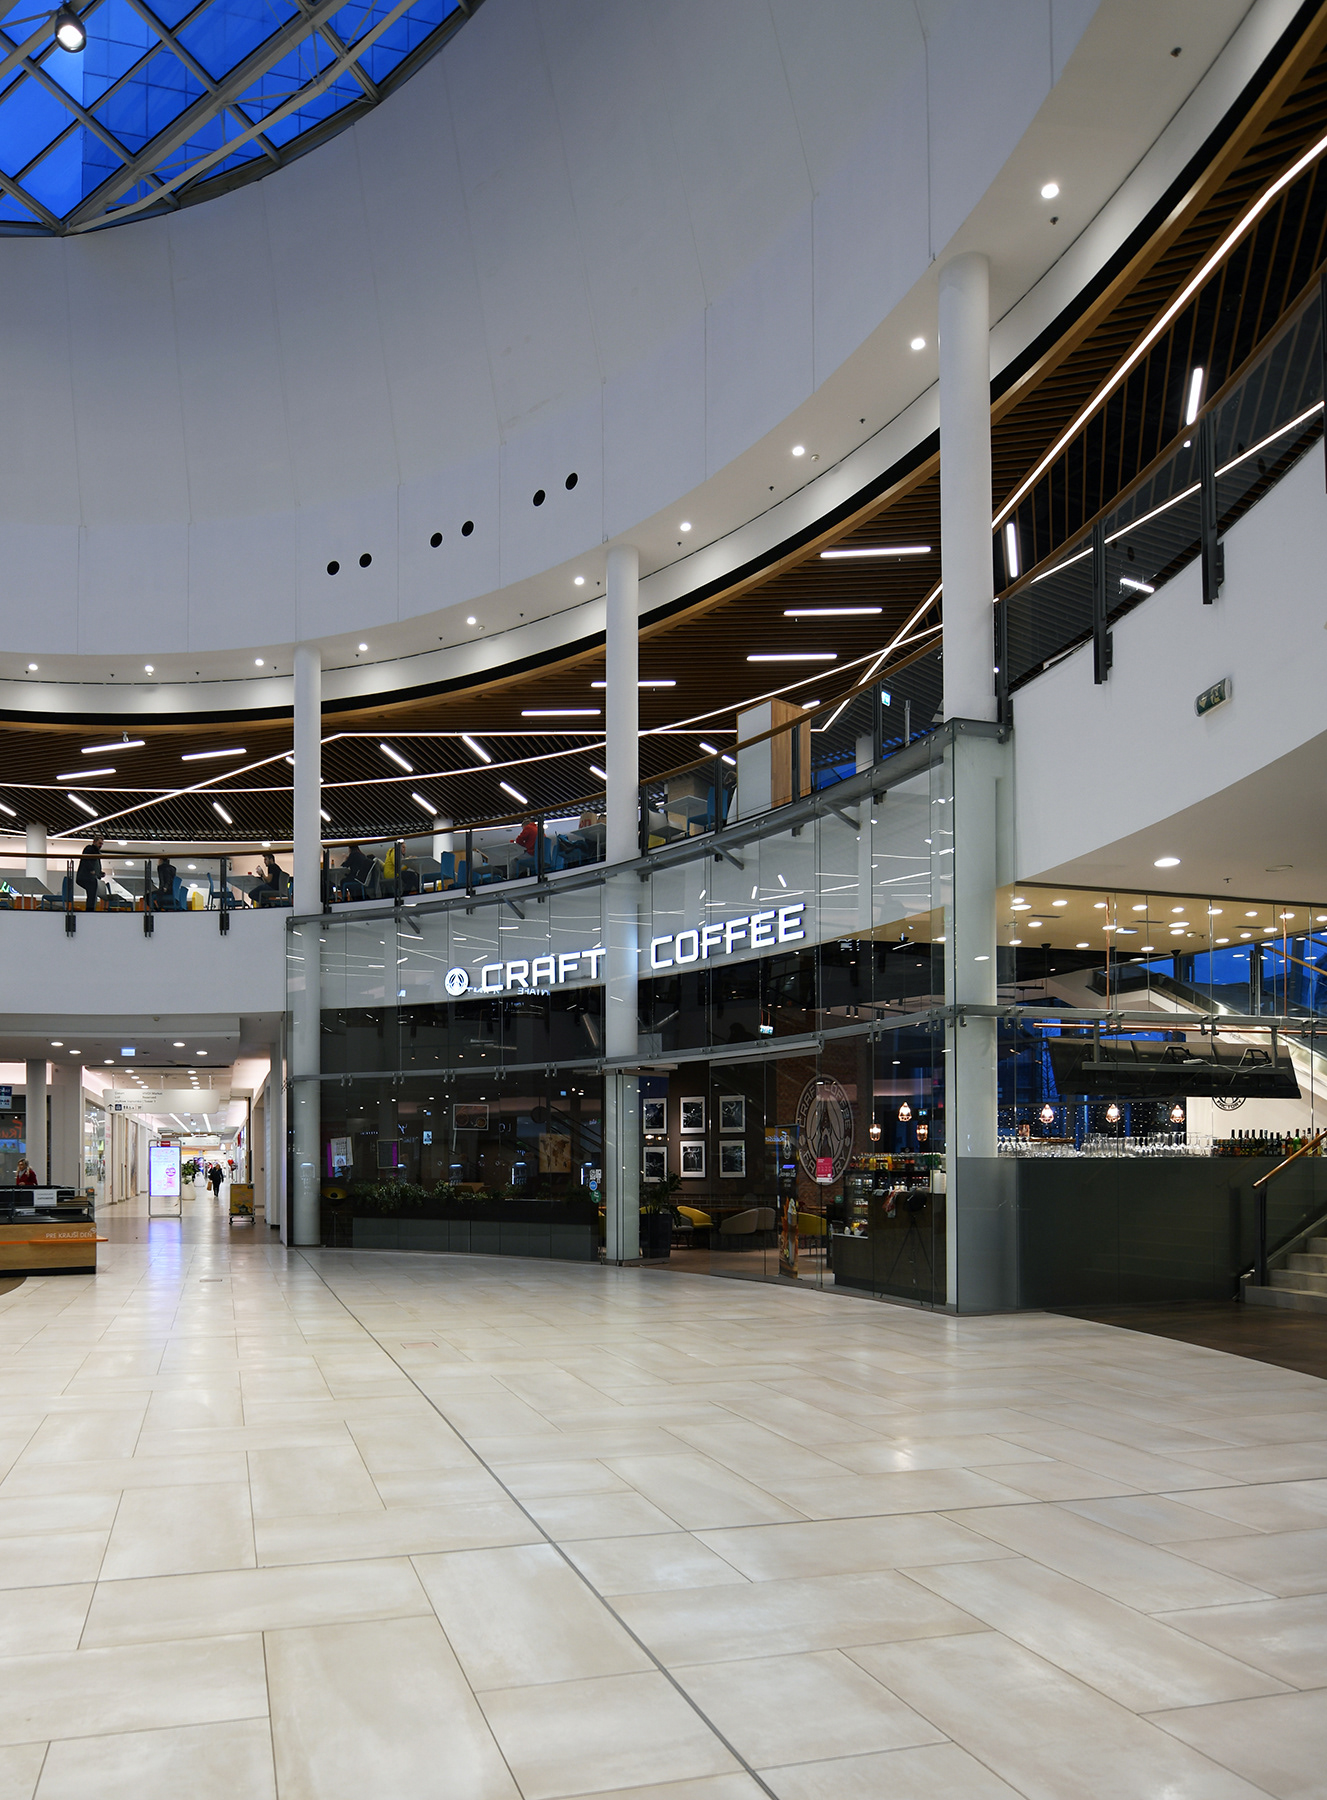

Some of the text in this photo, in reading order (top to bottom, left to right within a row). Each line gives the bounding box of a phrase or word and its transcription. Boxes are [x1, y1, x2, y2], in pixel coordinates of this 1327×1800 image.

[481, 903, 805, 992] CRAFT COFFEE
[824, 1080, 852, 1130] COFFEE
[803, 1150, 846, 1177] FARY
